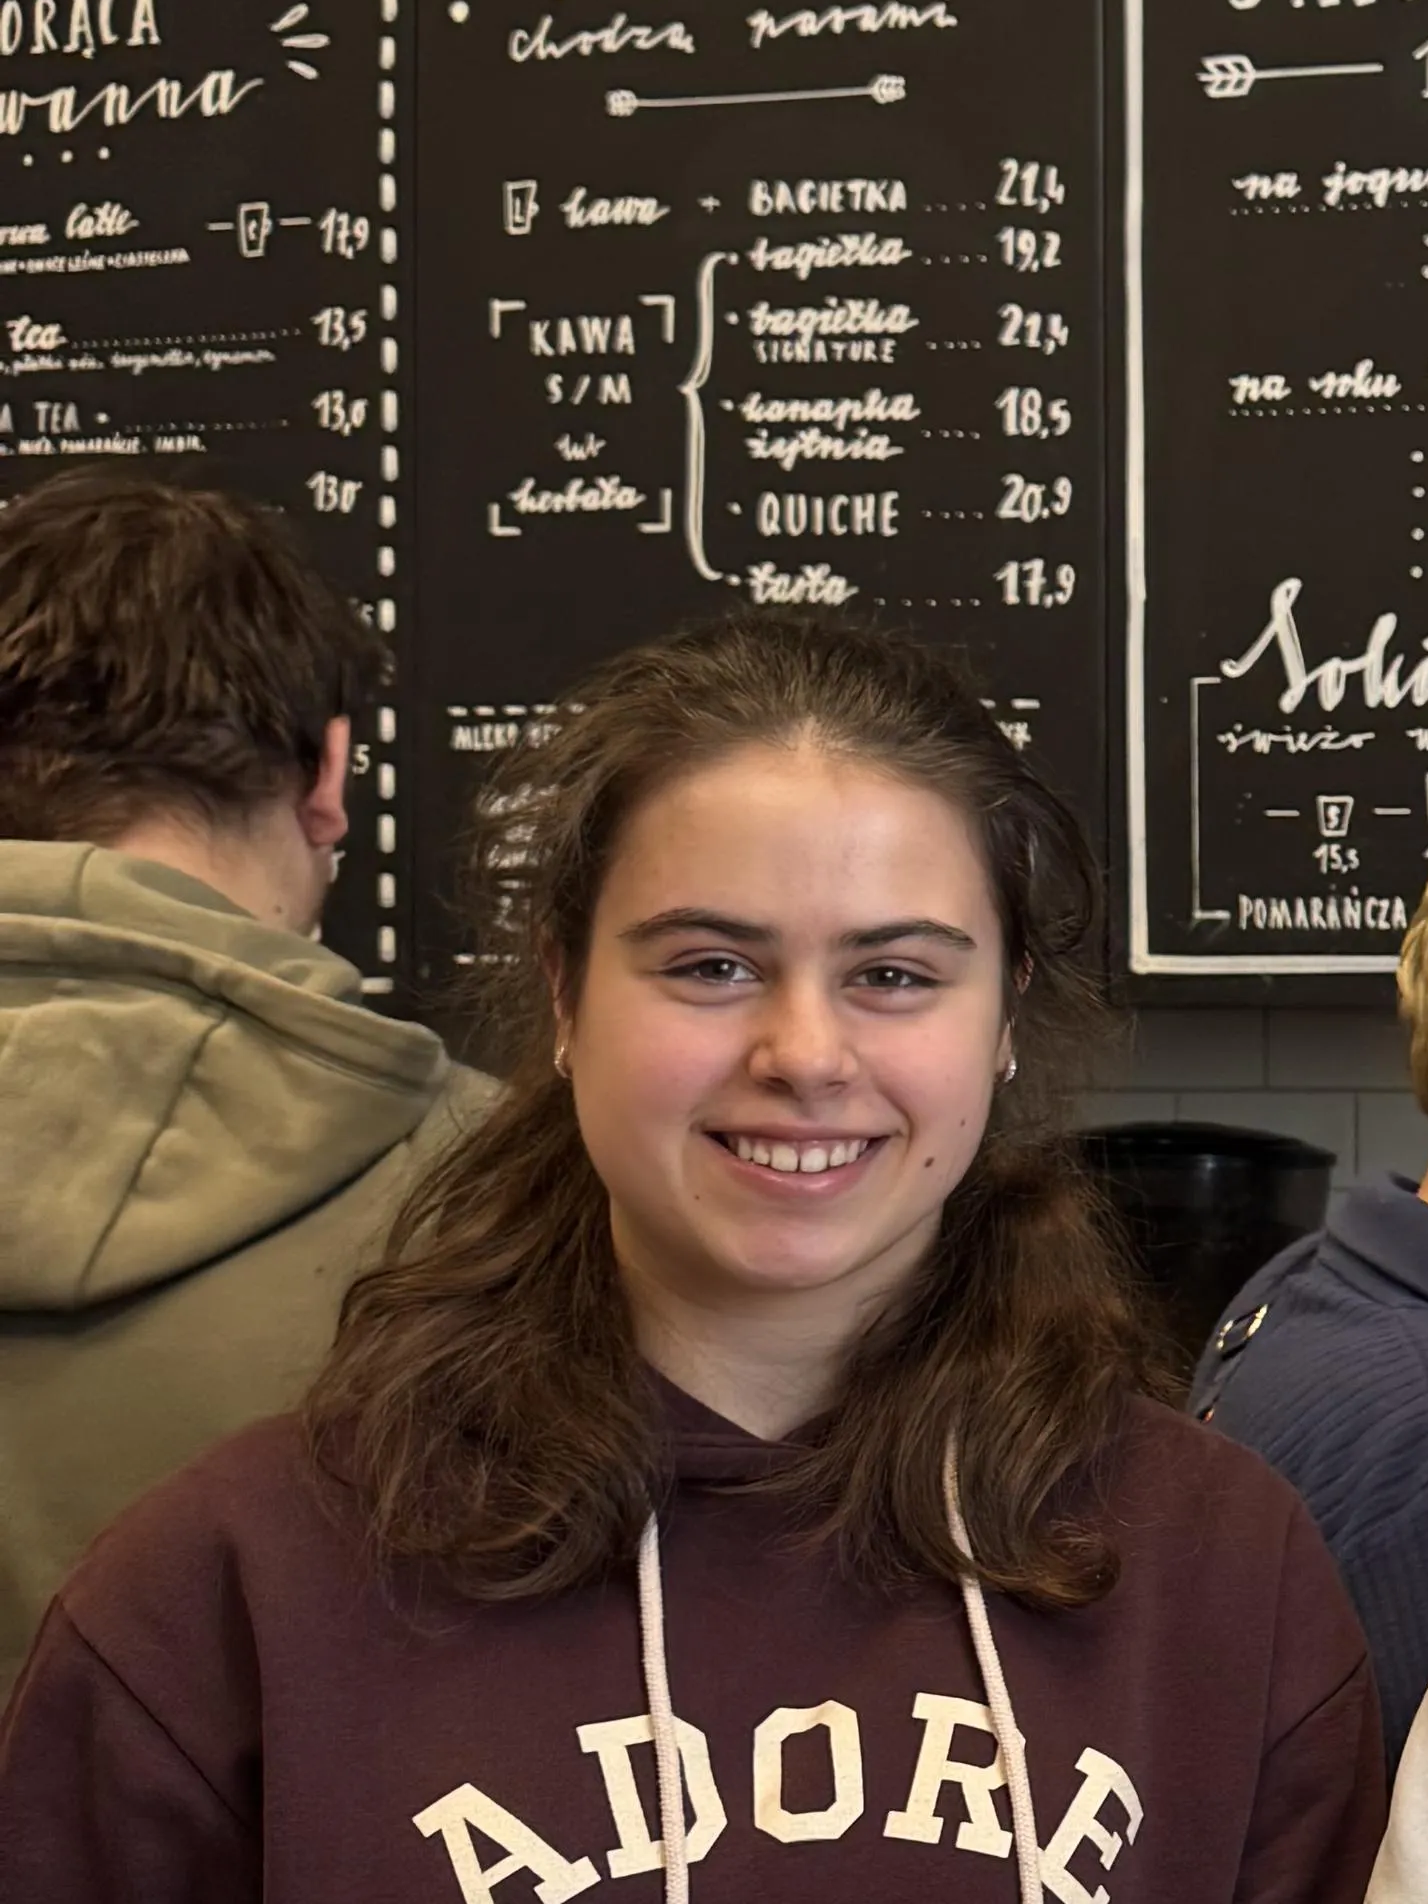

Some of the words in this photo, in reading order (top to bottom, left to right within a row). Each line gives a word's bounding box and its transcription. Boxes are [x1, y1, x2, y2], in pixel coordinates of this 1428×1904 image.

[510, 14, 694, 62] chodzą
[563, 188, 669, 227] kawa
[751, 179, 906, 215] BAGIETKA
[1234, 173, 1301, 200] na
[532, 316, 634, 355] KAWA
[754, 340, 896, 363] SIGNATURE
[1230, 375, 1291, 404] na
[1310, 359, 1401, 398] soku
[35, 402, 78, 433] TEA
[741, 389, 920, 431] kanapka
[747, 428, 903, 471] żytnia
[511, 476, 645, 512] herbata
[759, 492, 898, 536] QUICHE
[749, 562, 857, 605] tarta
[1218, 724, 1375, 753] świeżo
[1240, 887, 1407, 929] POMARAŃCZA
